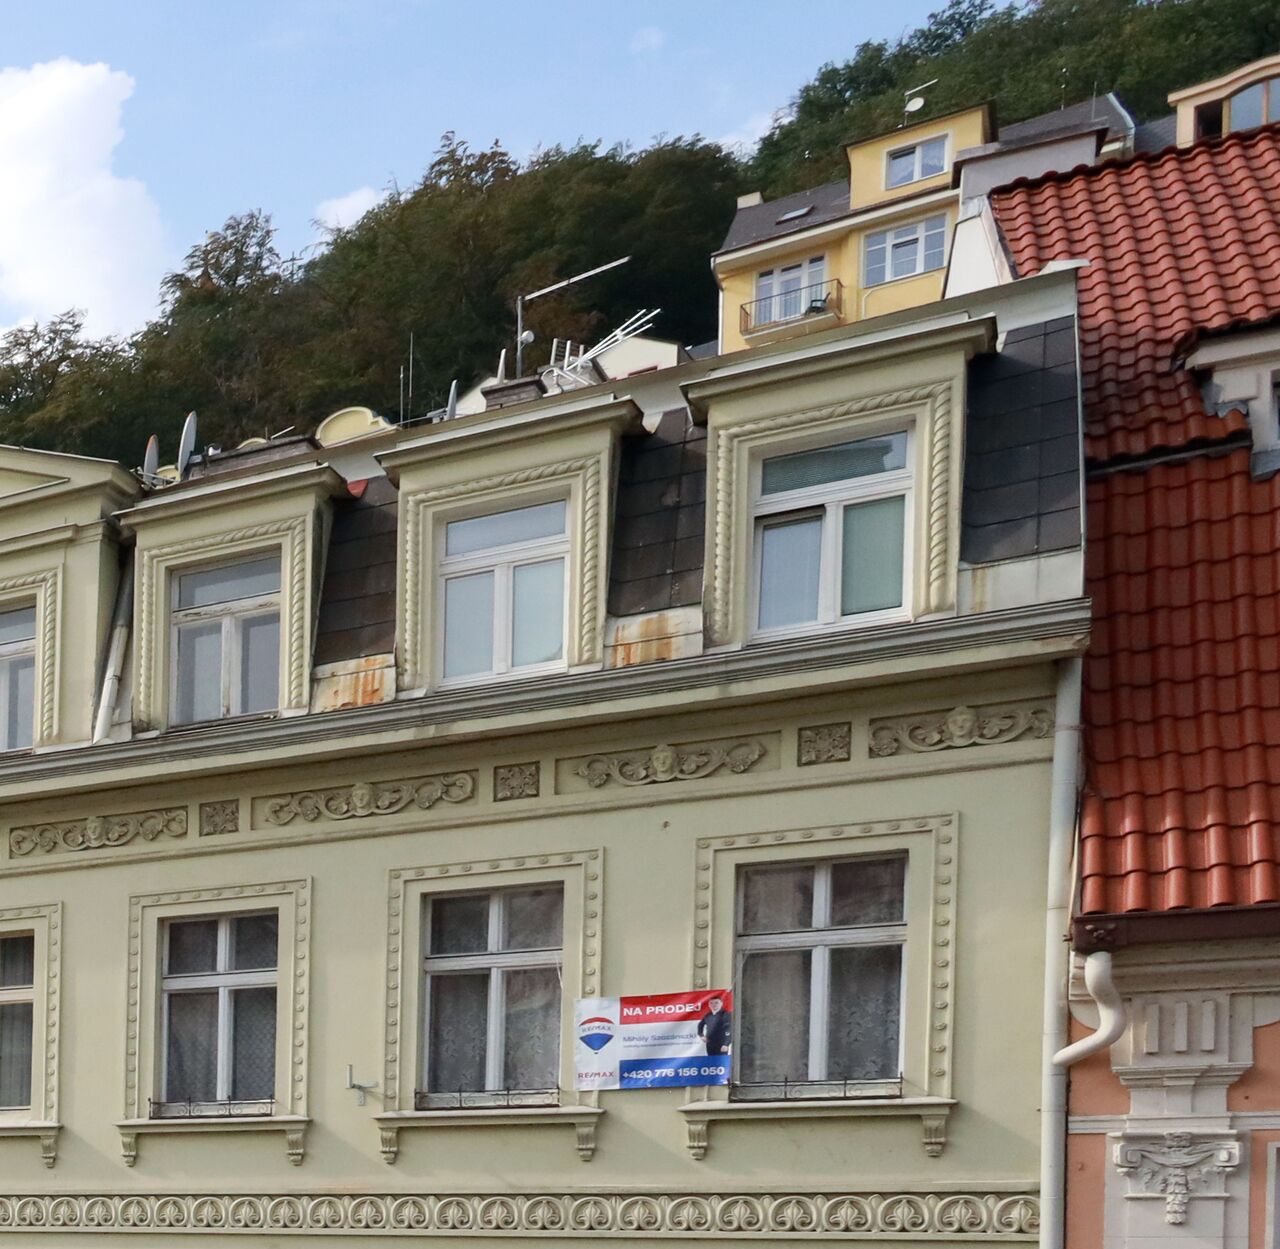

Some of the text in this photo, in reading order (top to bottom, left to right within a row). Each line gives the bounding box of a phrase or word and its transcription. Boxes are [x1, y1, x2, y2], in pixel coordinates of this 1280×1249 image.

[623, 1003, 702, 1016] NA PRODEJ
[577, 1071, 615, 1079] RE/MAX
[622, 1066, 725, 1079] +420 776 156 050
